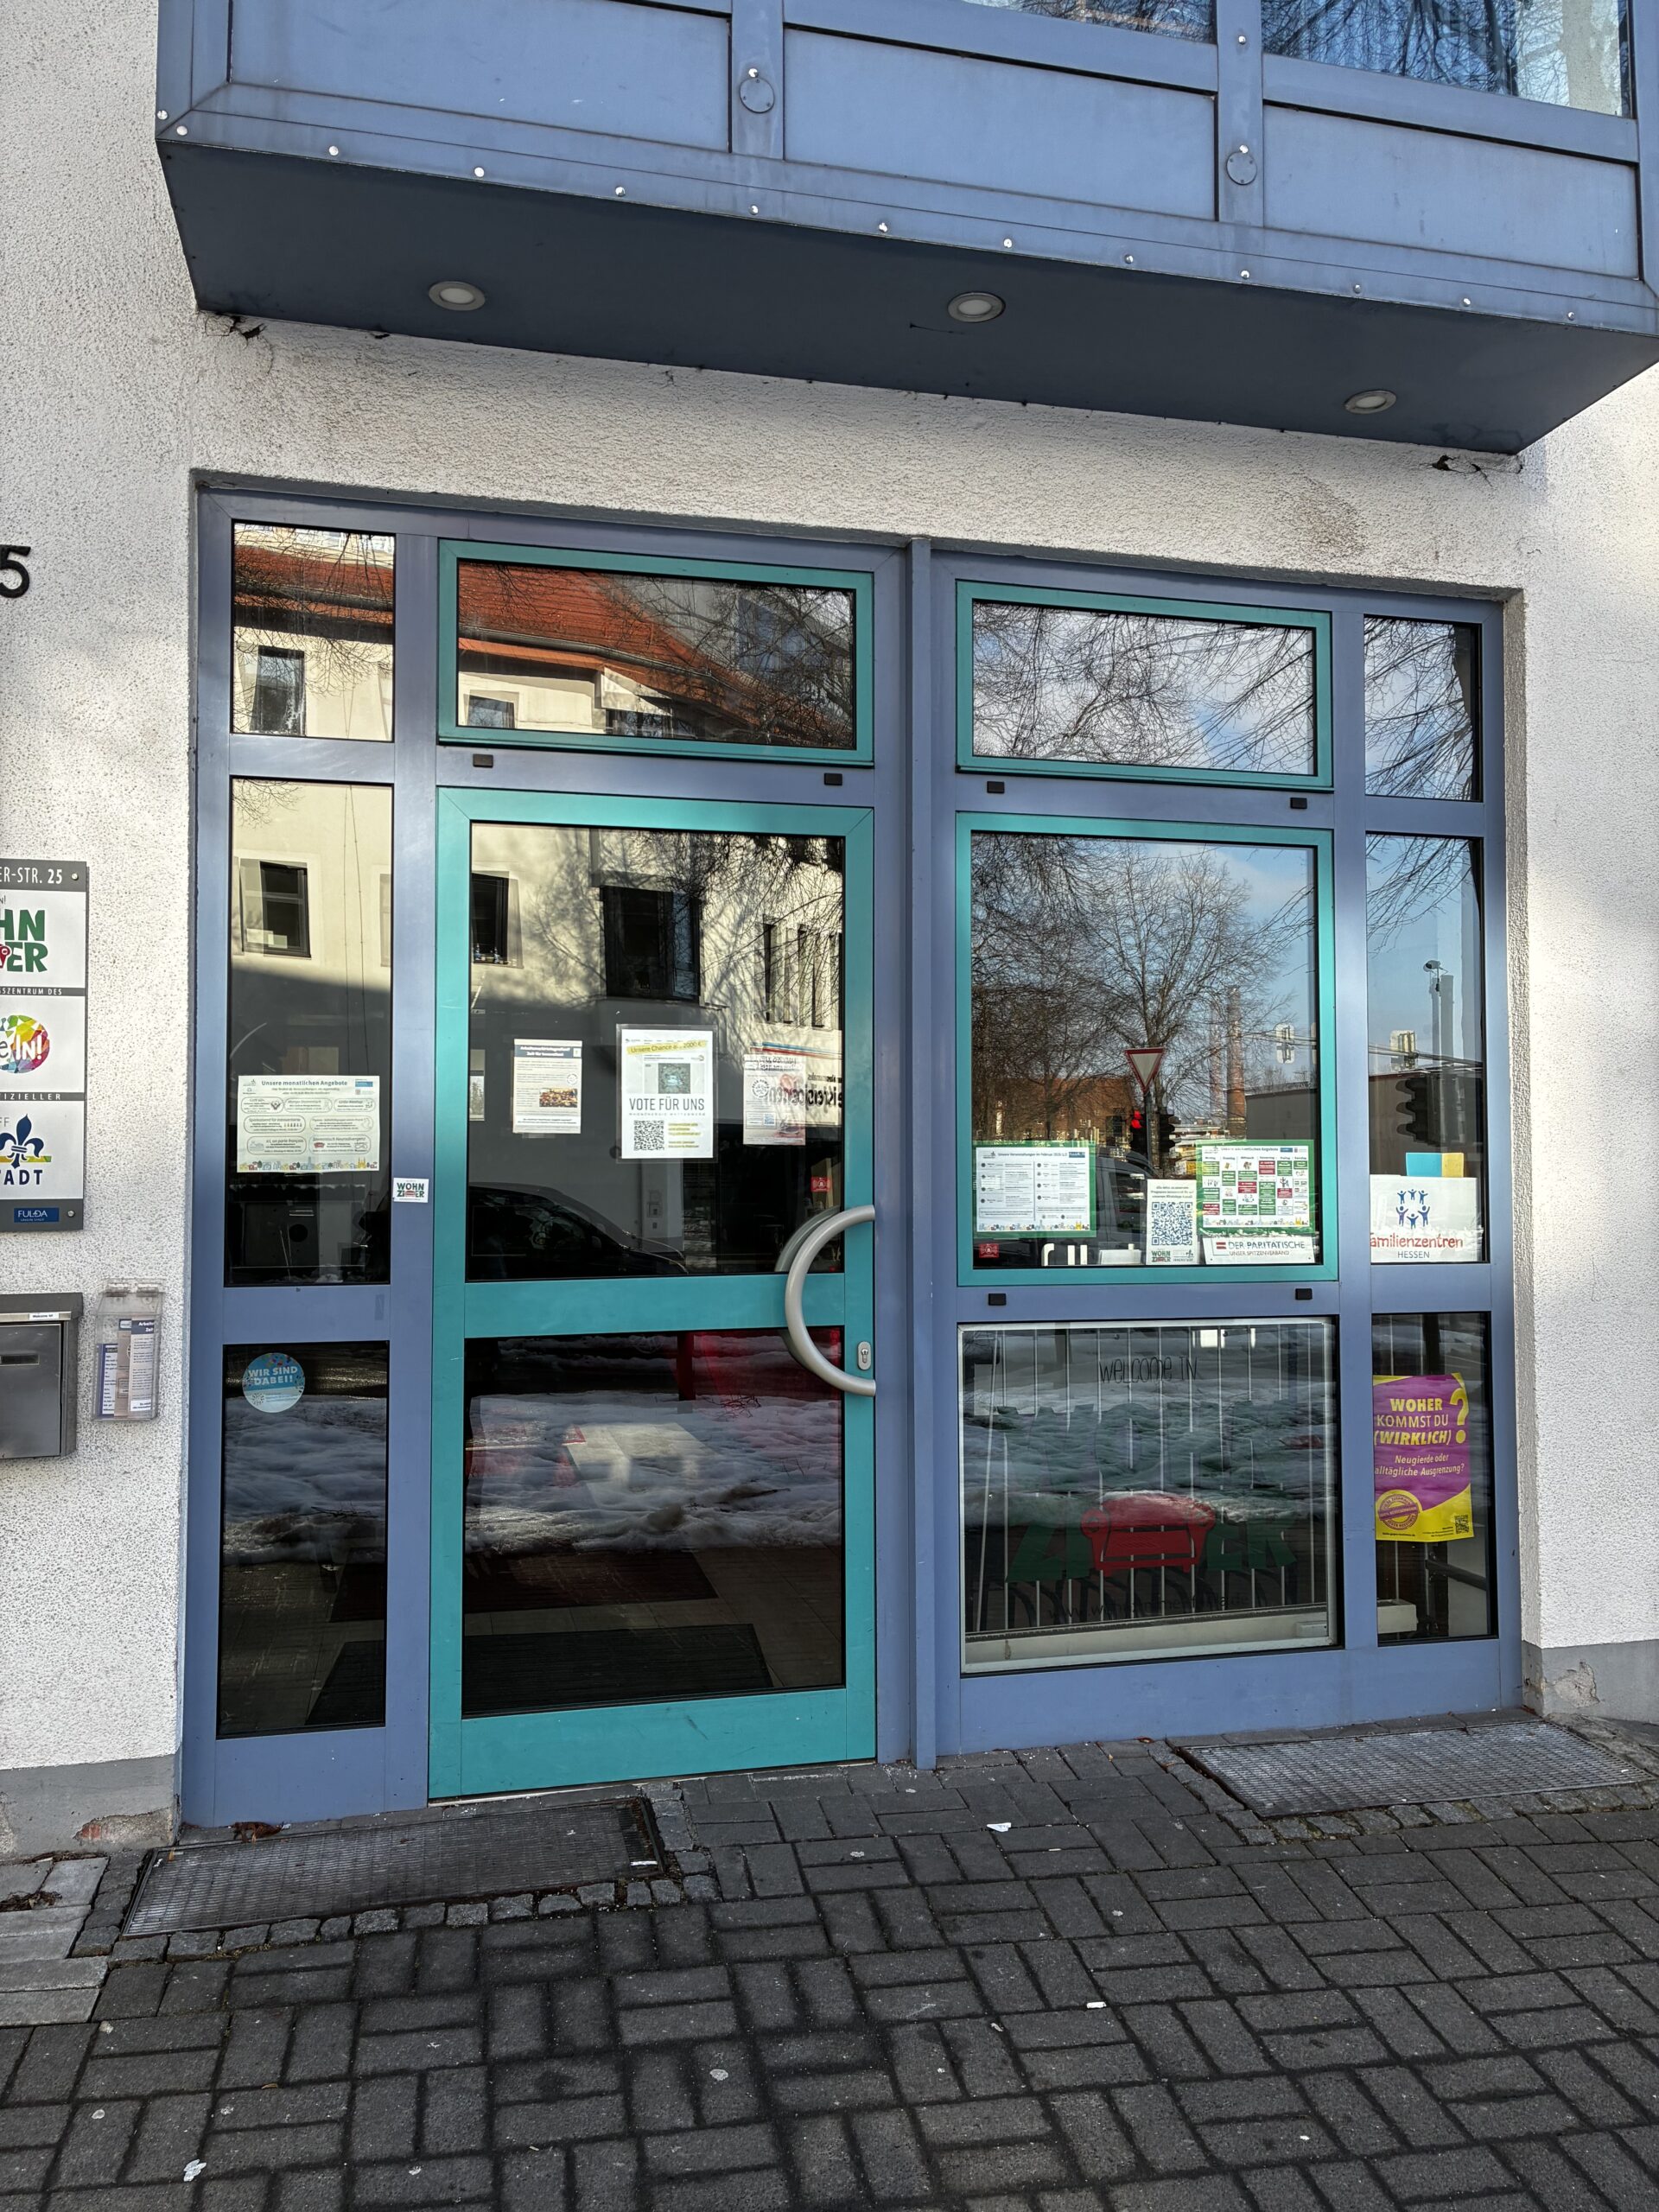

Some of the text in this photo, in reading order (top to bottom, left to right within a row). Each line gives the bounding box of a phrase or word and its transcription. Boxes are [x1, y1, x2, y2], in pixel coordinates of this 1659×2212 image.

[0, 544, 31, 599] 5
[48, 868, 63, 885] 25
[16, 1033, 42, 1061] IN!
[629, 1096, 705, 1111] VOTE FÜR UNS
[397, 1182, 425, 1191] WOHN
[1228, 1241, 1244, 1249] DER
[1397, 1250, 1430, 1259] HESSEN
[248, 1365, 298, 1377] WIR SIND
[253, 1375, 294, 1385] DABEI!
[1389, 1398, 1443, 1412] WOHER
[1376, 1414, 1448, 1428] KOMMST DU
[1374, 1429, 1452, 1446] (WIRKLICH)
[1395, 1453, 1449, 1466] Neugierde oder
[1375, 1463, 1465, 1478] alltägliche Ausgrenzung?
